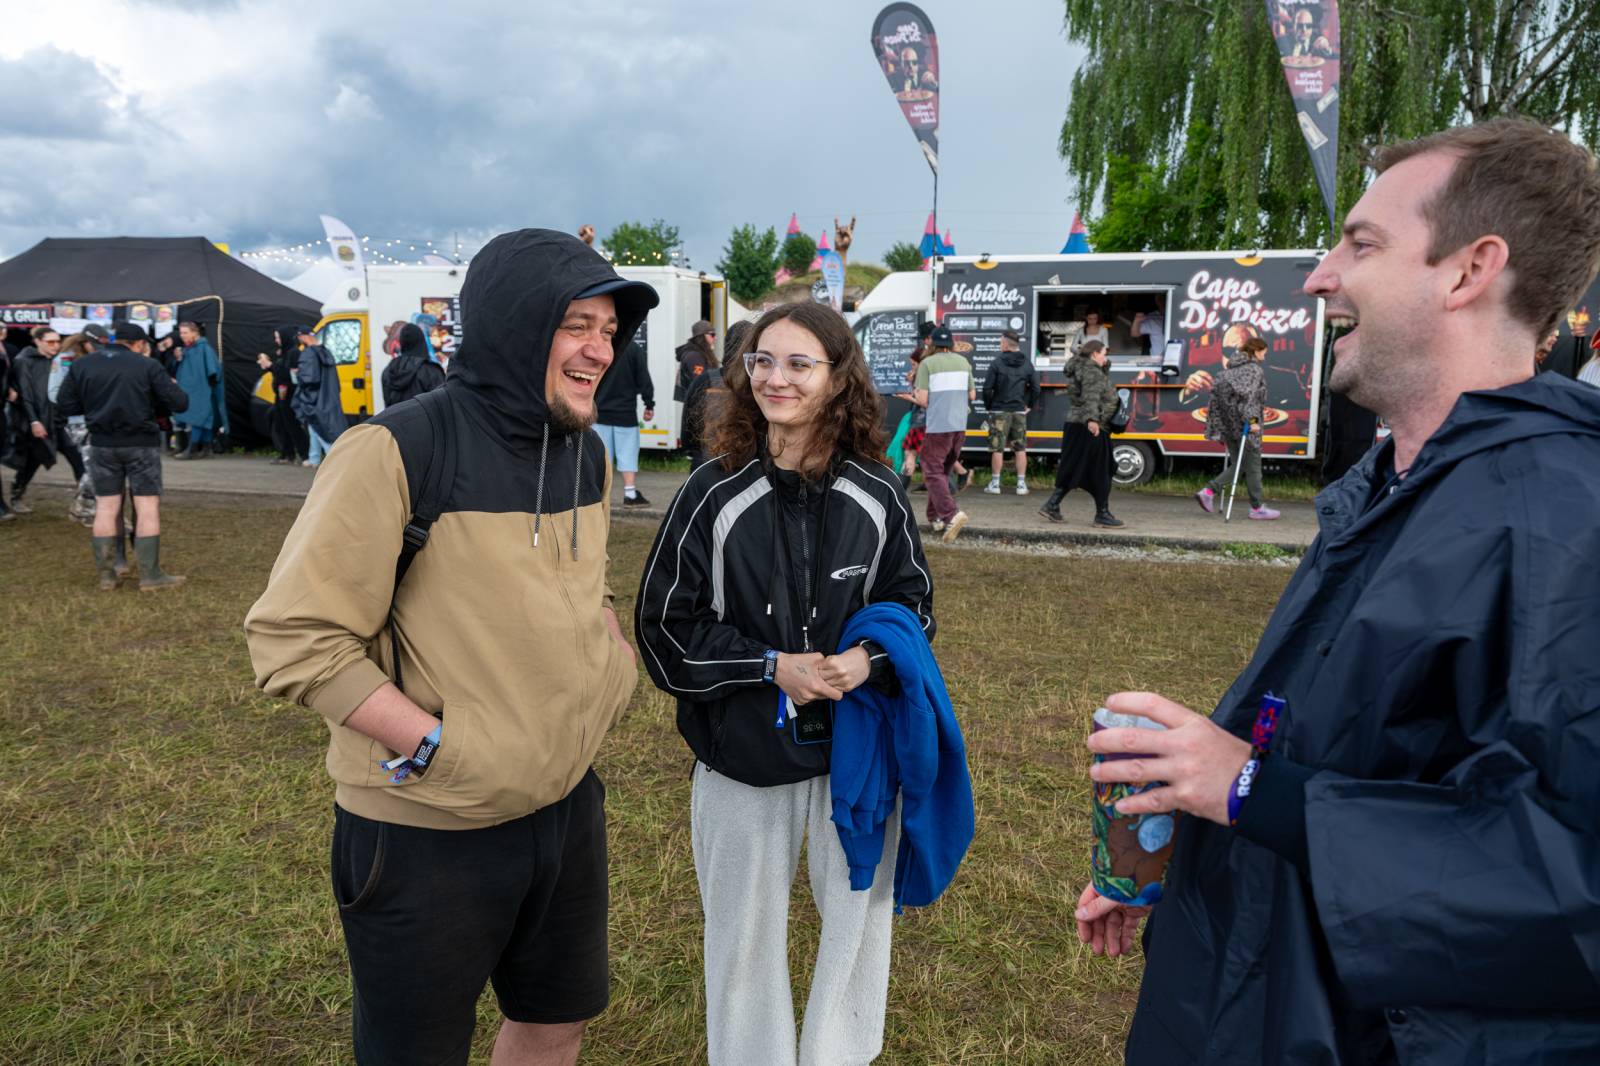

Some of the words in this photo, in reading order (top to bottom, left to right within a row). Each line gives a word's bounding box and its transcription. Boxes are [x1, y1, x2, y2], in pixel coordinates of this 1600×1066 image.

[1187, 270, 1260, 307] Capo
[3, 311, 13, 322] &
[15, 311, 48, 323] GRILL
[442, 309, 454, 325] 1
[1179, 300, 1220, 329] Di
[1222, 298, 1311, 334] Pizza
[442, 335, 456, 352] 2
